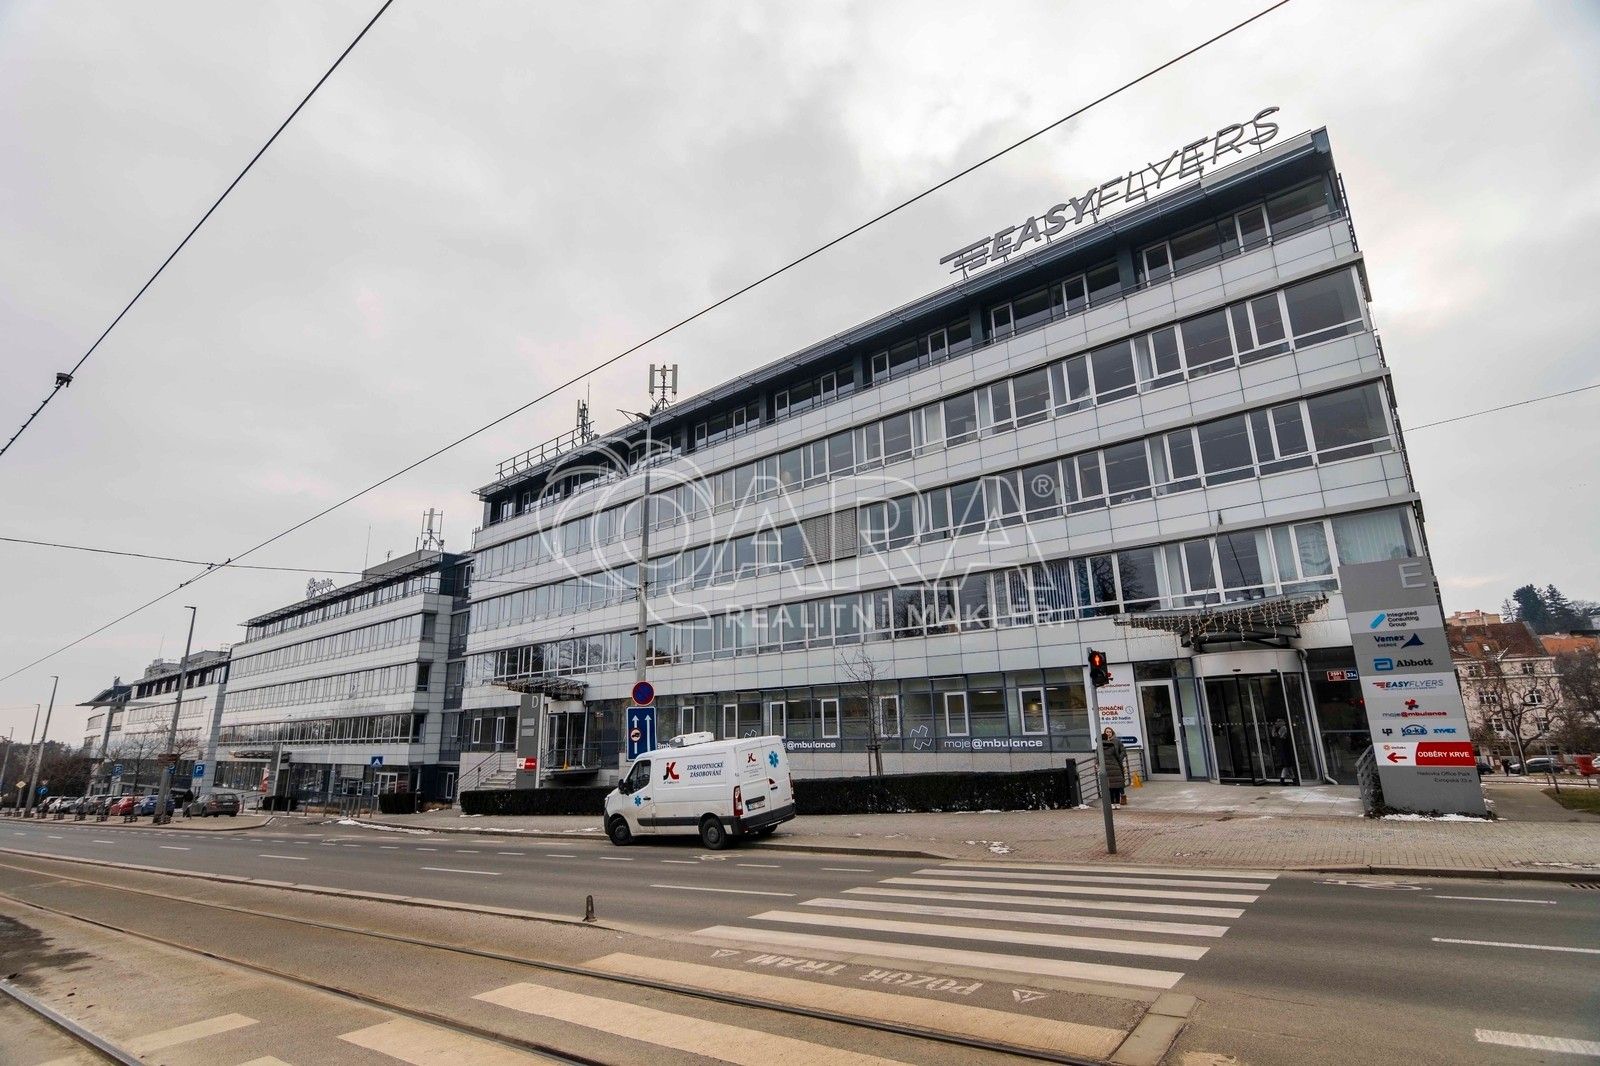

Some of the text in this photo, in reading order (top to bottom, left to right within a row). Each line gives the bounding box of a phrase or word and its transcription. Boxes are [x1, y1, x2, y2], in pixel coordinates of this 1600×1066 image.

[991, 106, 1280, 261] EASYFLYERS
[1398, 561, 1427, 588] E
[1386, 610, 1418, 618] Integrated
[1387, 615, 1420, 623] Consulting
[1396, 657, 1434, 667] Abbott
[1385, 679, 1444, 688] EASYFLYERS
[531, 695, 539, 709] D
[1382, 710, 1448, 718] moje@mbulance
[944, 738, 1043, 750] moje@mbulance
[1417, 750, 1448, 758] ODBĚRY
[686, 761, 724, 771] ZDRAVOTNICKÉ
[689, 769, 722, 778] ZÁSOBOVÁNÍ
[746, 953, 984, 996] POZOR TRAM
